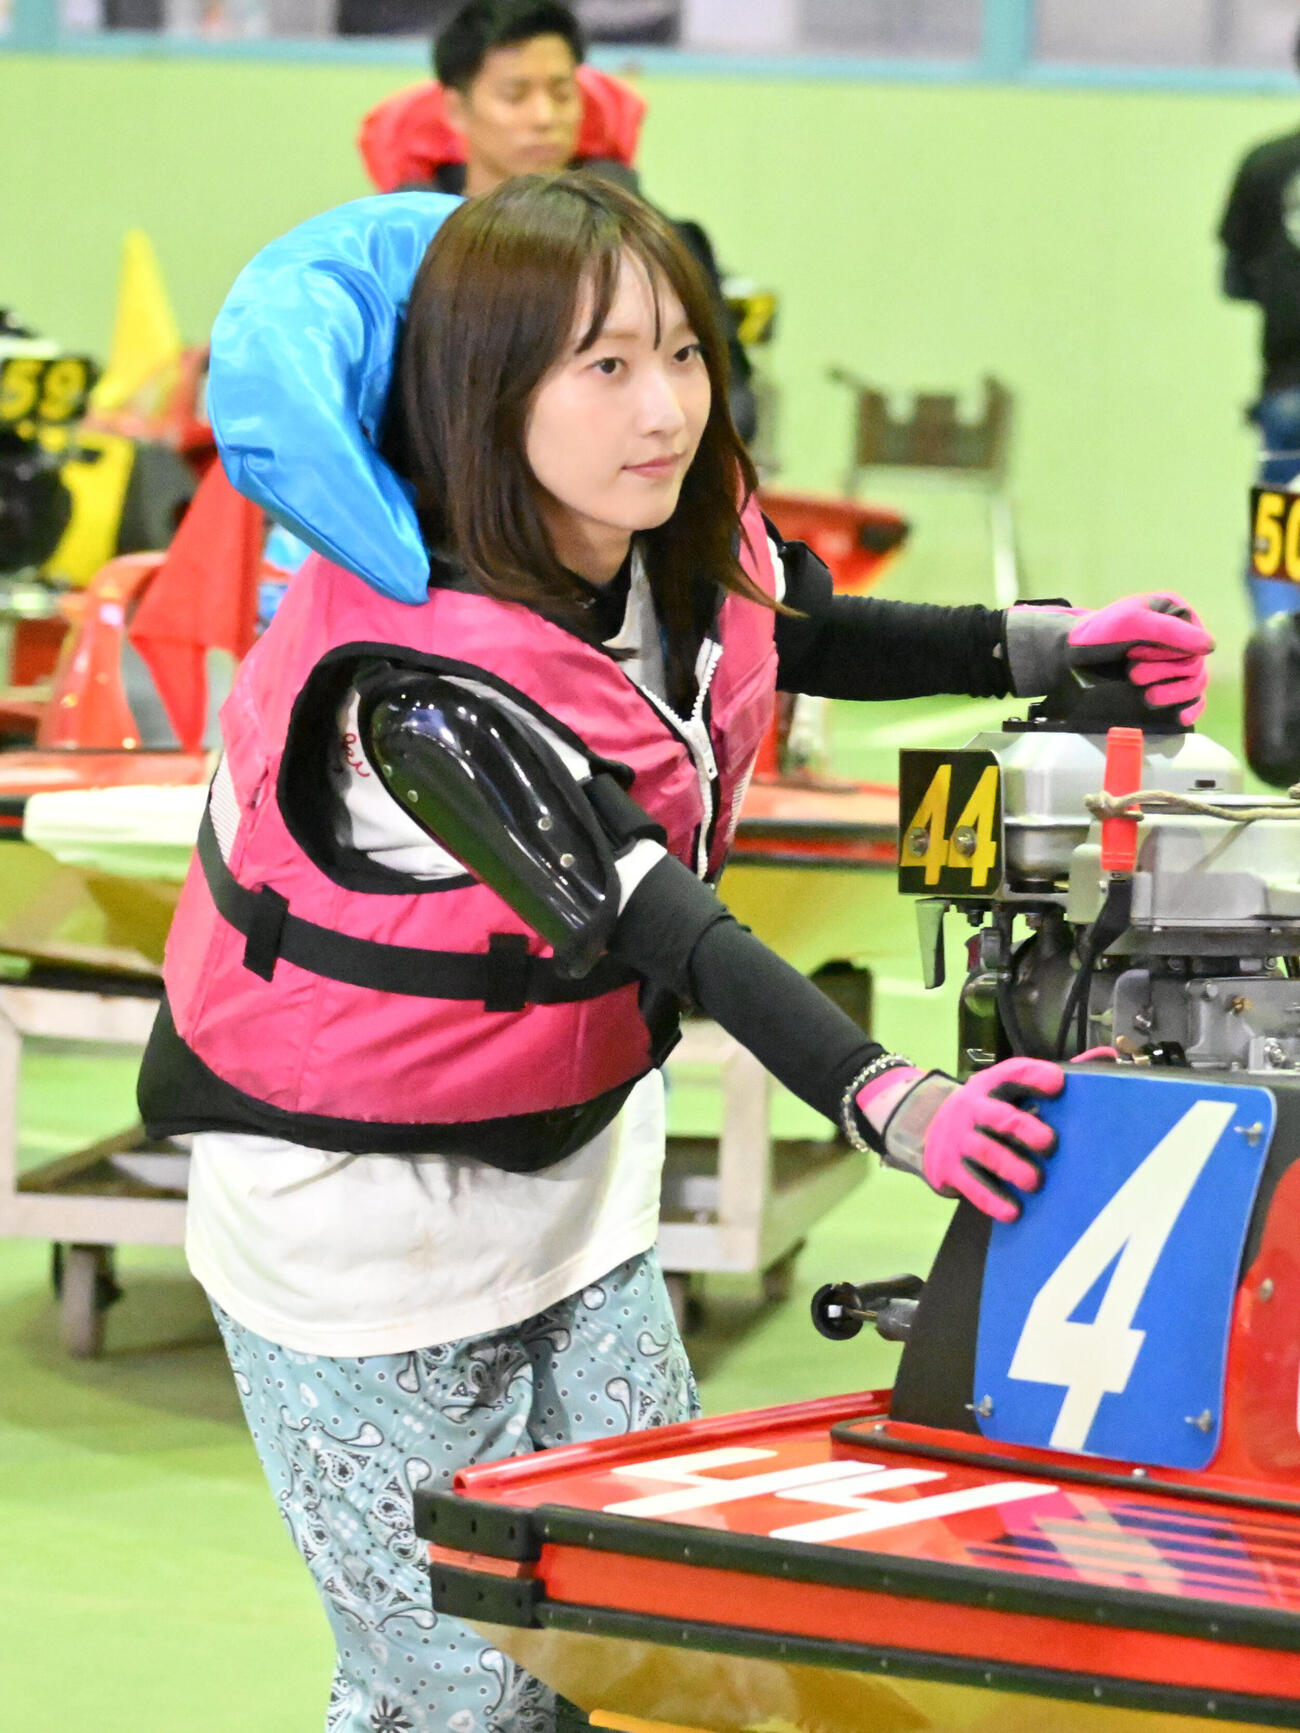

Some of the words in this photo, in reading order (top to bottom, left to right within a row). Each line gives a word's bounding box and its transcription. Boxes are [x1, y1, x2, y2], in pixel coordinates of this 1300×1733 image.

[0, 358, 84, 419] 59
[900, 763, 998, 887] 44
[1007, 1100, 1238, 1451] 4
